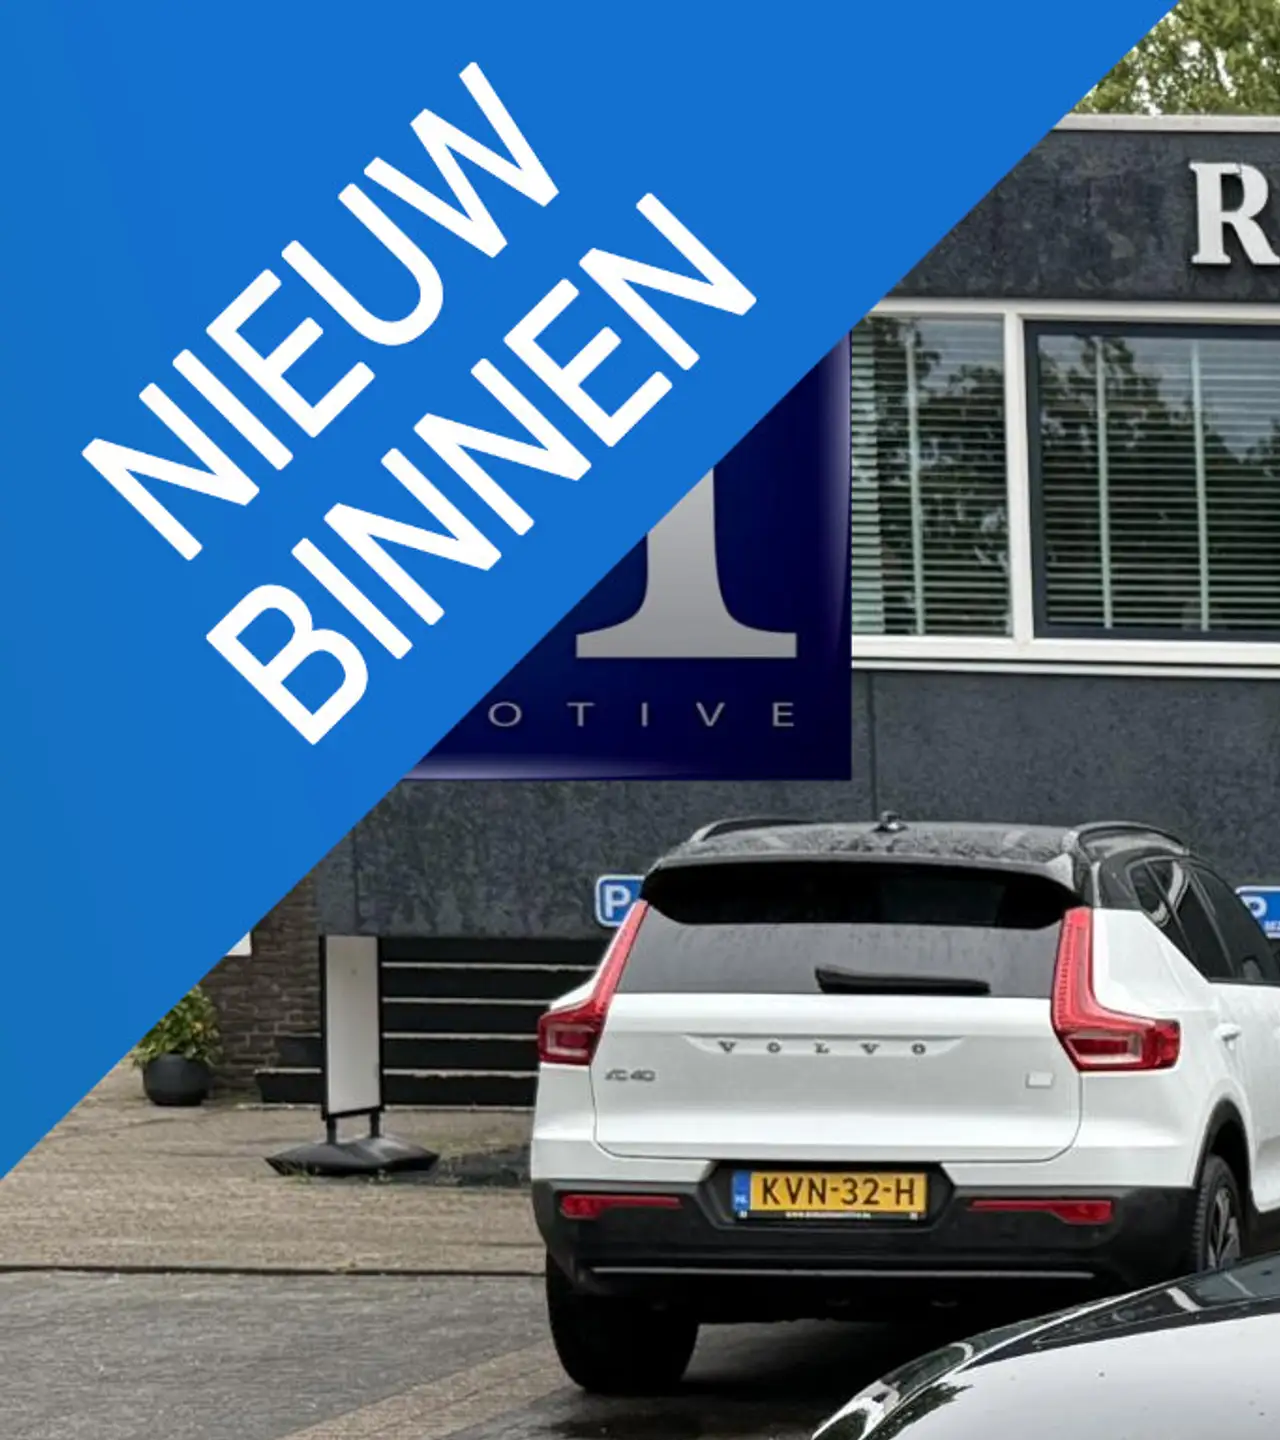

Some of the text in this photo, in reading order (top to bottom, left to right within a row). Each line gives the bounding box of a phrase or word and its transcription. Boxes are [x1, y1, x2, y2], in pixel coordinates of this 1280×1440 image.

[488, 702, 795, 727] OTIVE
[605, 885, 630, 918] P
[718, 1040, 926, 1056] VOLVO
[762, 1177, 914, 1205] KVN-32-H
